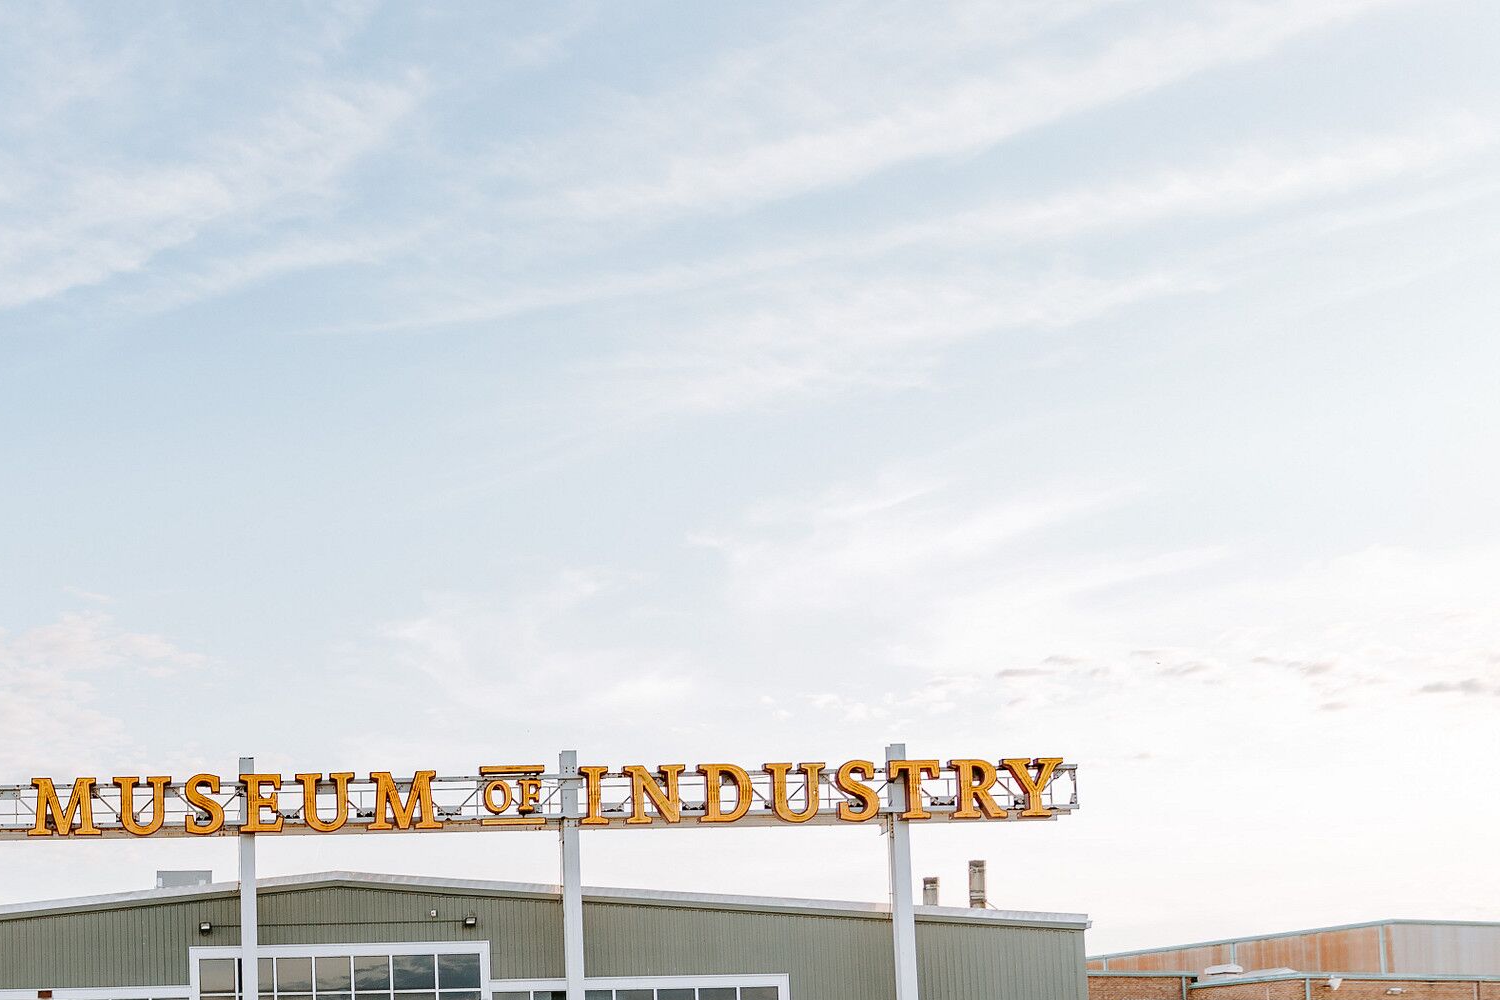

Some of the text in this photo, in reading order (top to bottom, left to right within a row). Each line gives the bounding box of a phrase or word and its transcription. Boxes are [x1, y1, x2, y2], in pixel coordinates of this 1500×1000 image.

[27, 770, 443, 836] MUSEUM
[483, 779, 541, 814] OF
[578, 757, 1063, 825] INDUSTRY
